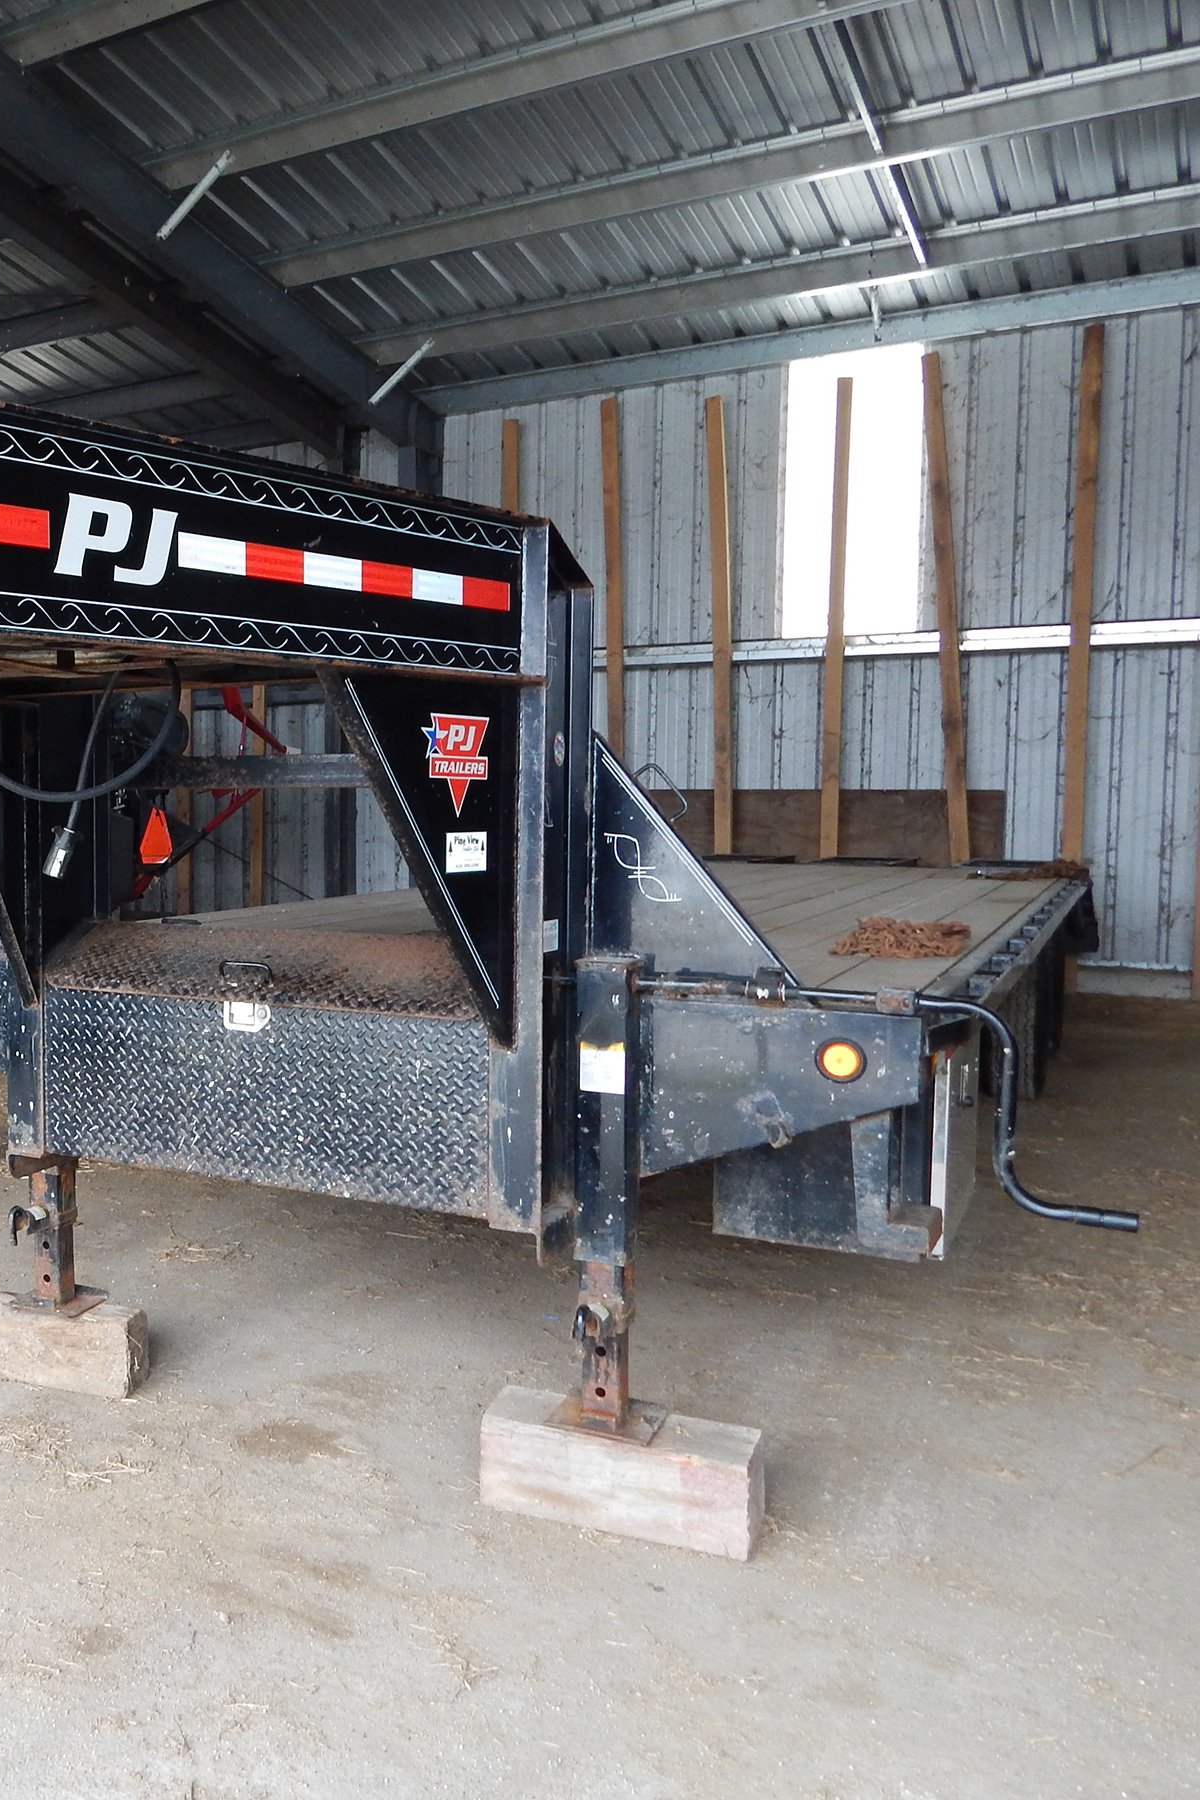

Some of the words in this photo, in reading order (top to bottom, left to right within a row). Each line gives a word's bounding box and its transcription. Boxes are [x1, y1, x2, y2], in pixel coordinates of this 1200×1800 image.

[53, 492, 178, 587] PJ
[446, 724, 477, 752] PJ
[434, 760, 485, 775] TRAILERS
